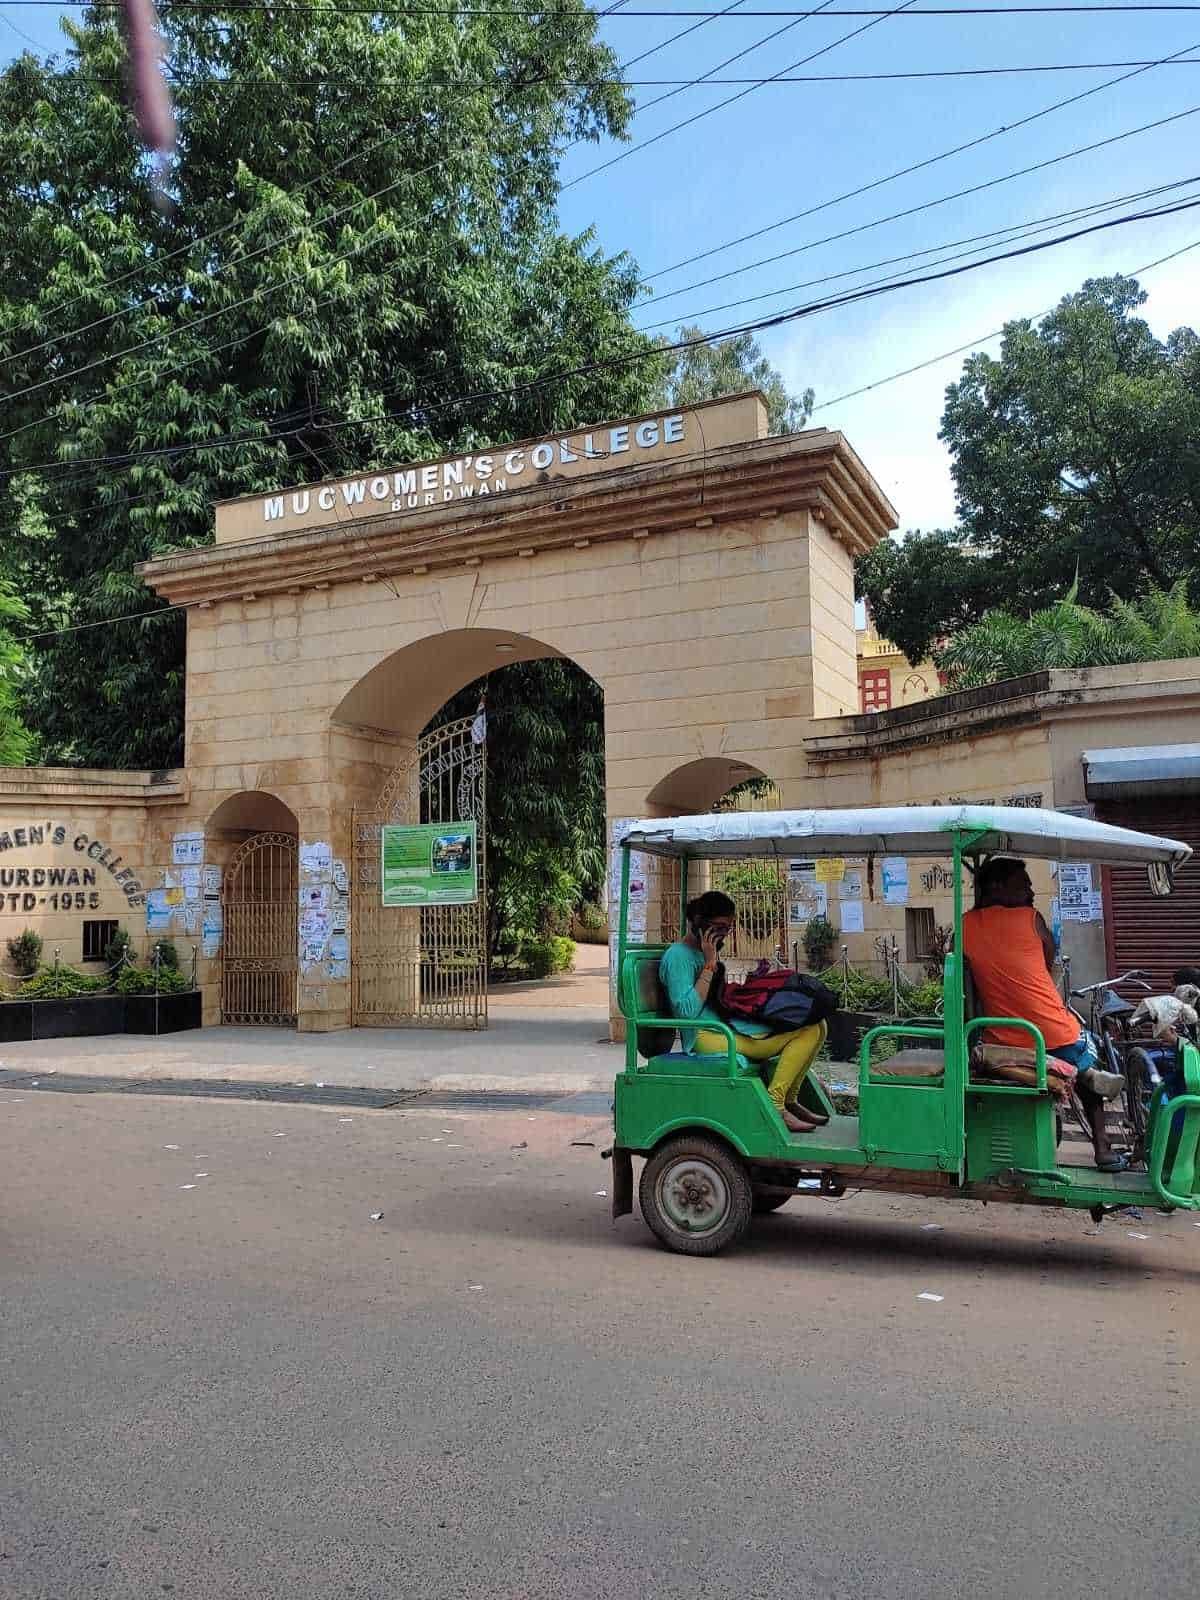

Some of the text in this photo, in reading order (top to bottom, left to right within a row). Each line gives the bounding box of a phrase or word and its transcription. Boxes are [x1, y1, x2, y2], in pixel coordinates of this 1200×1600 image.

[264, 415, 686, 521] MUC WOMEN'S COLLEGE
[391, 478, 507, 512] BURDWAN
[73, 832, 148, 908] COLLEGE
